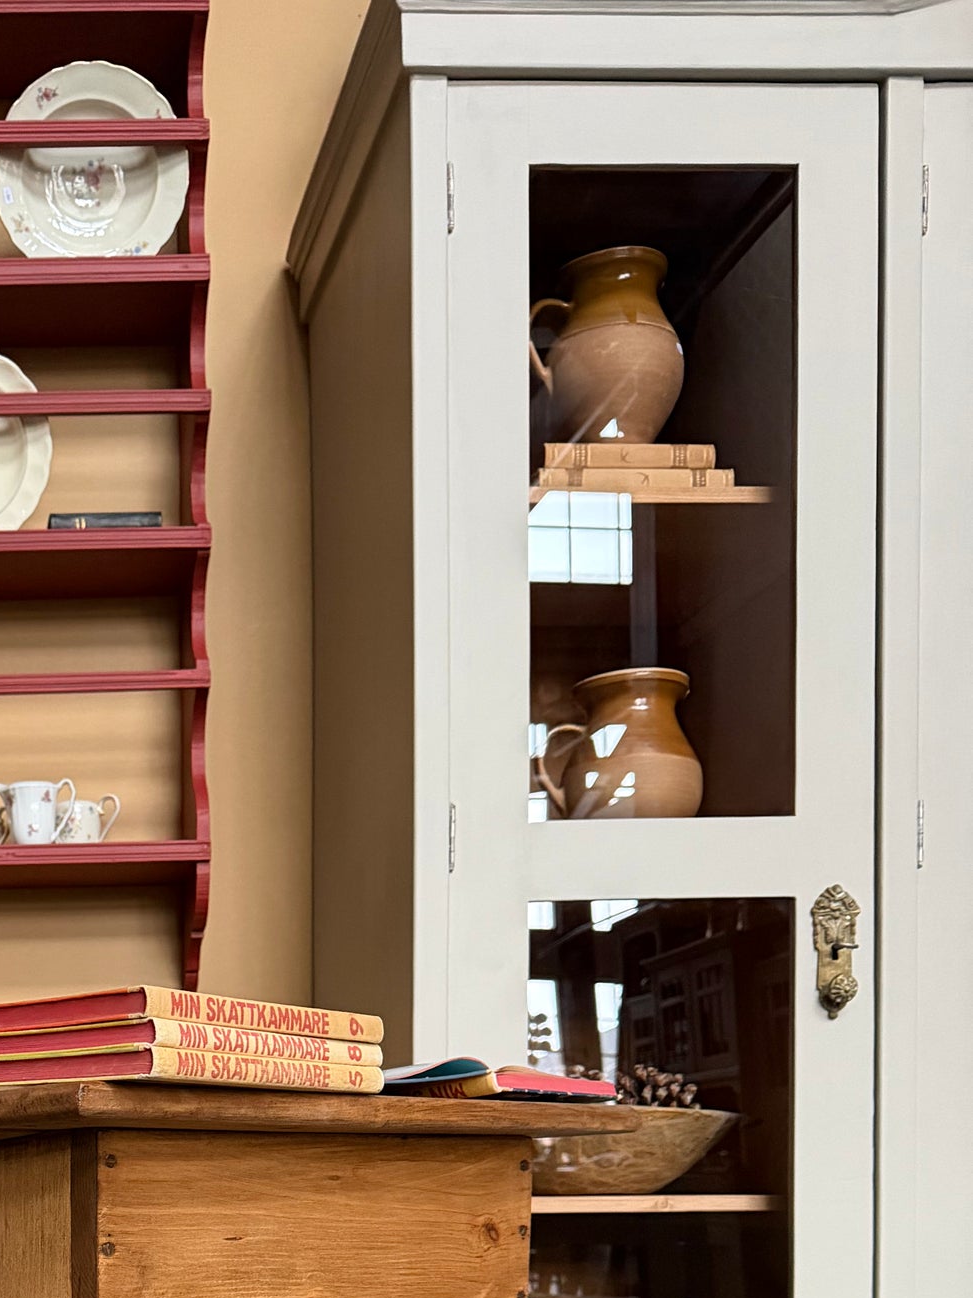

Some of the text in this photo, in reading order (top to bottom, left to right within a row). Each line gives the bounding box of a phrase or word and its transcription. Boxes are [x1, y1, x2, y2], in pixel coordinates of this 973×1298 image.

[170, 991, 201, 1020] MIN
[206, 997, 330, 1035] SKATTKAMMARE
[178, 1023, 363, 1062] MIN SKATTKAMMARE 8
[176, 1051, 364, 1088] MIN SKATTKAMMARE 5
